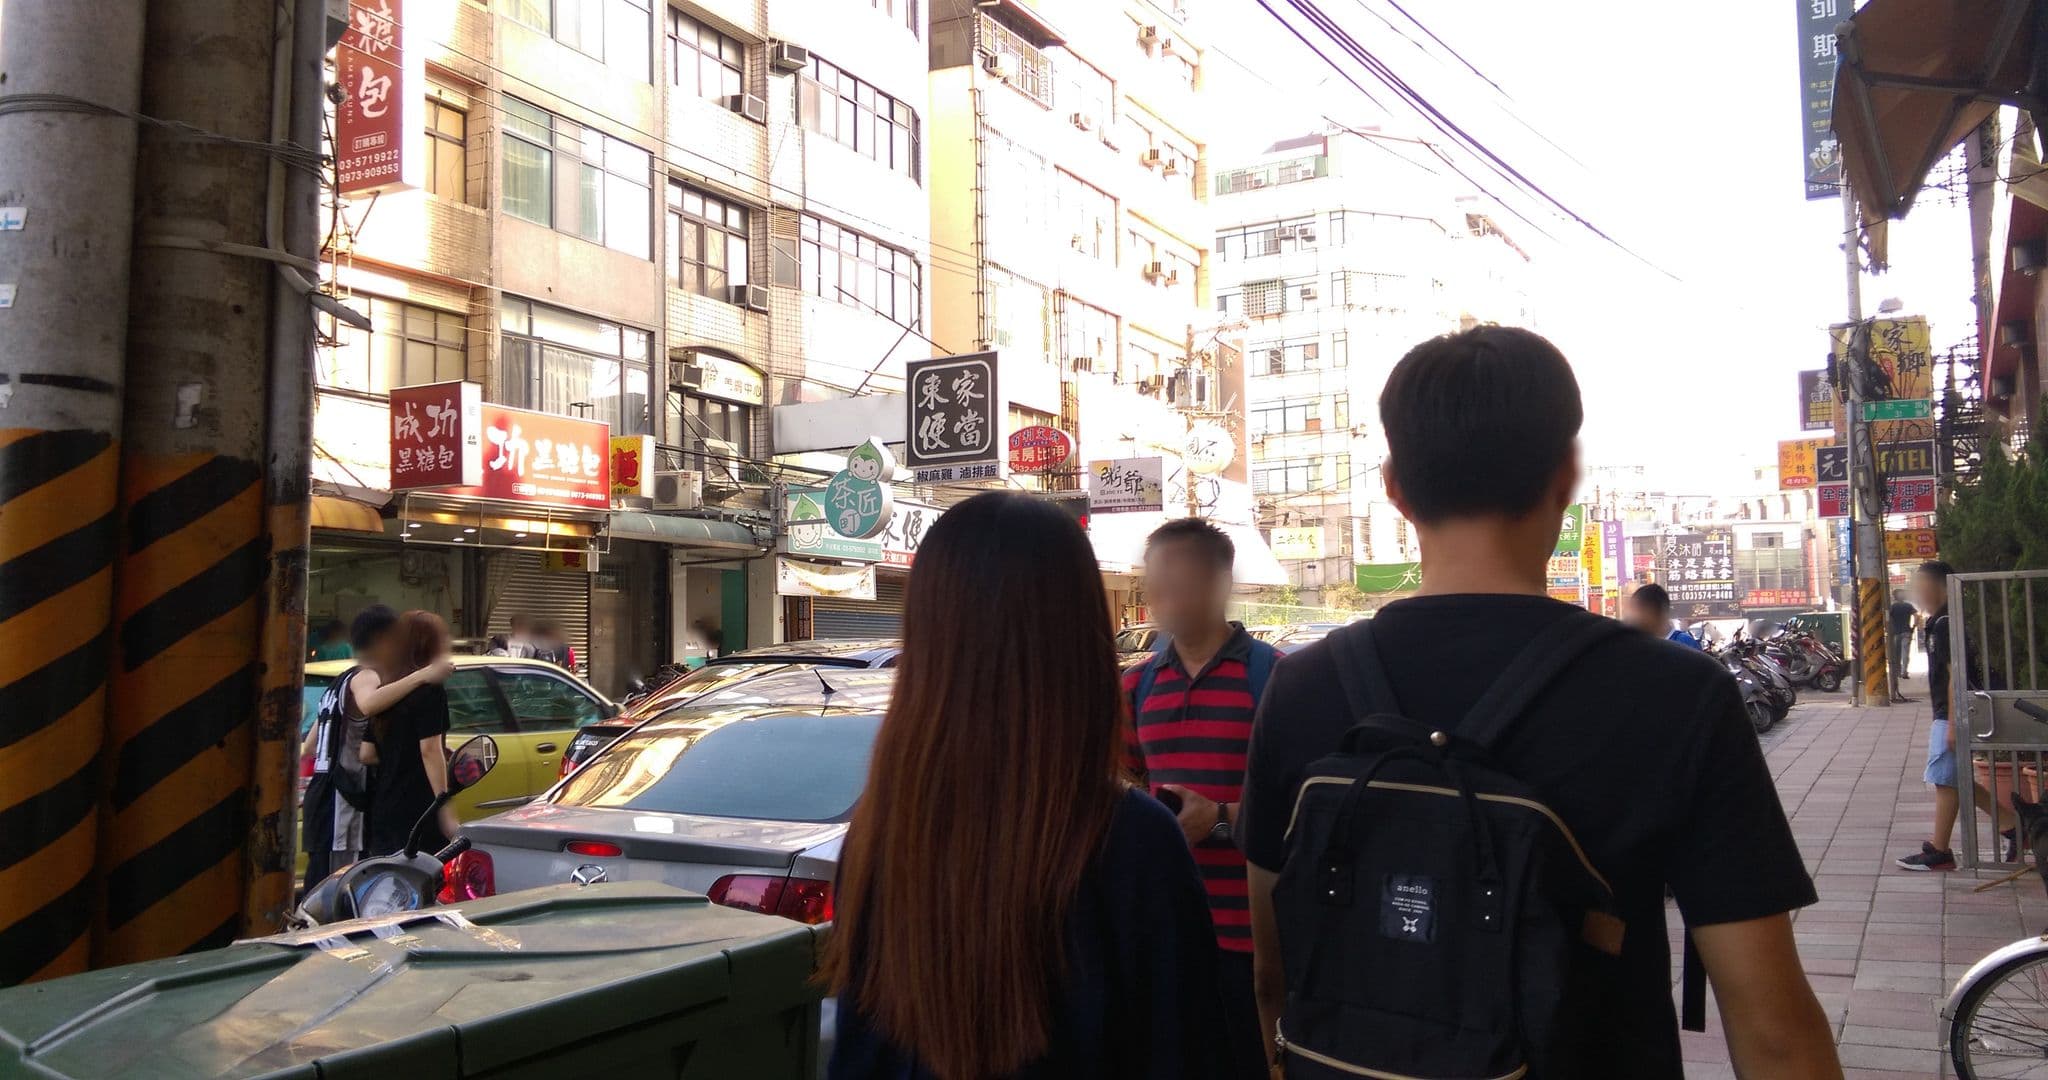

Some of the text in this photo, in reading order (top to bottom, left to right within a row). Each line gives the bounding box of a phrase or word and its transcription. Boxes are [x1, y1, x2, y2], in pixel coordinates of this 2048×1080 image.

[339, 149, 399, 170] 03-5719922
[338, 163, 399, 184] 0973-909353
[919, 370, 985, 410] 東家
[394, 399, 458, 444] 成功
[918, 409, 985, 451] 便當
[395, 445, 456, 474] 黑糖包
[959, 464, 998, 480] 滷排飯
[1397, 885, 1428, 895] anello
